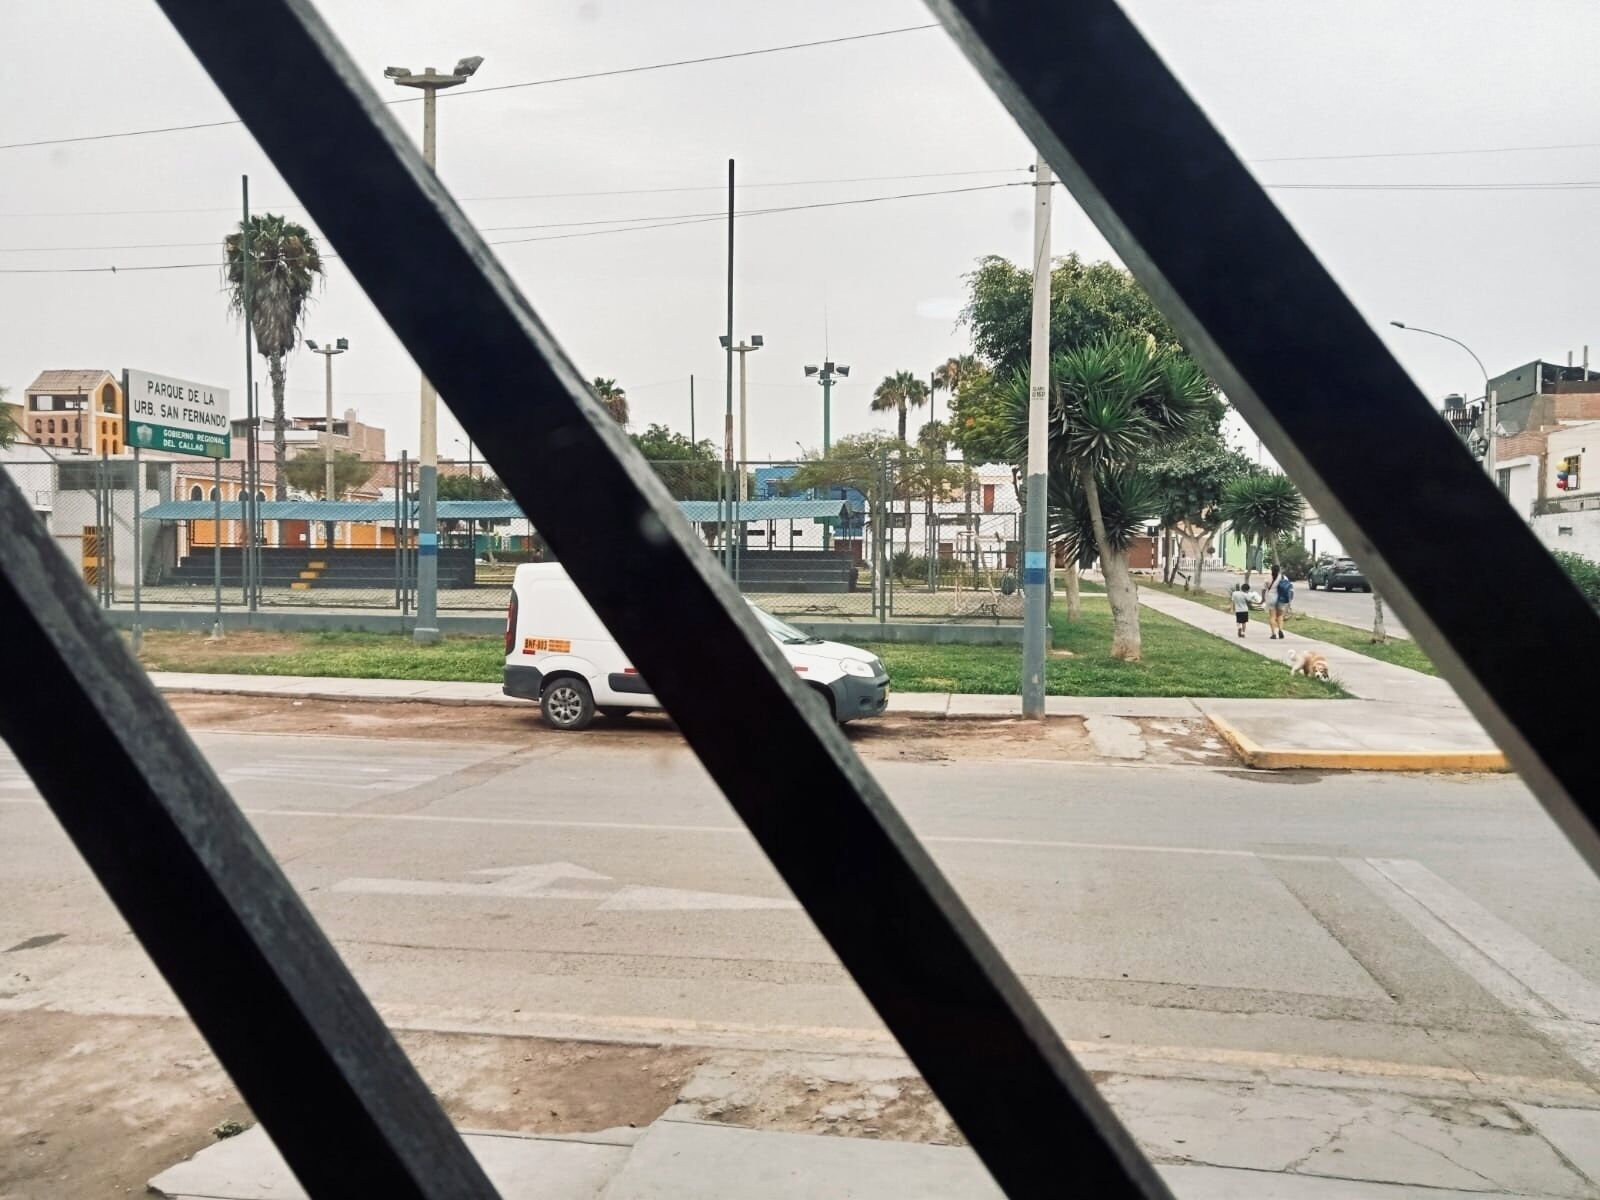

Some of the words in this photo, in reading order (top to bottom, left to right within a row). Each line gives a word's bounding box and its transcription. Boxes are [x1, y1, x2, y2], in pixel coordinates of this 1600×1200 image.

[148, 380, 184, 400] PARQUE
[188, 388, 200, 403] DE
[204, 391, 215, 406] LA
[134, 400, 156, 416] URB.
[160, 404, 179, 420] SAN
[183, 408, 226, 428] FERNANDO
[163, 429, 194, 440] GOBIERNO
[197, 434, 225, 445] REGIONAL
[163, 439, 176, 448] DEL
[178, 441, 204, 451] CALLAO
